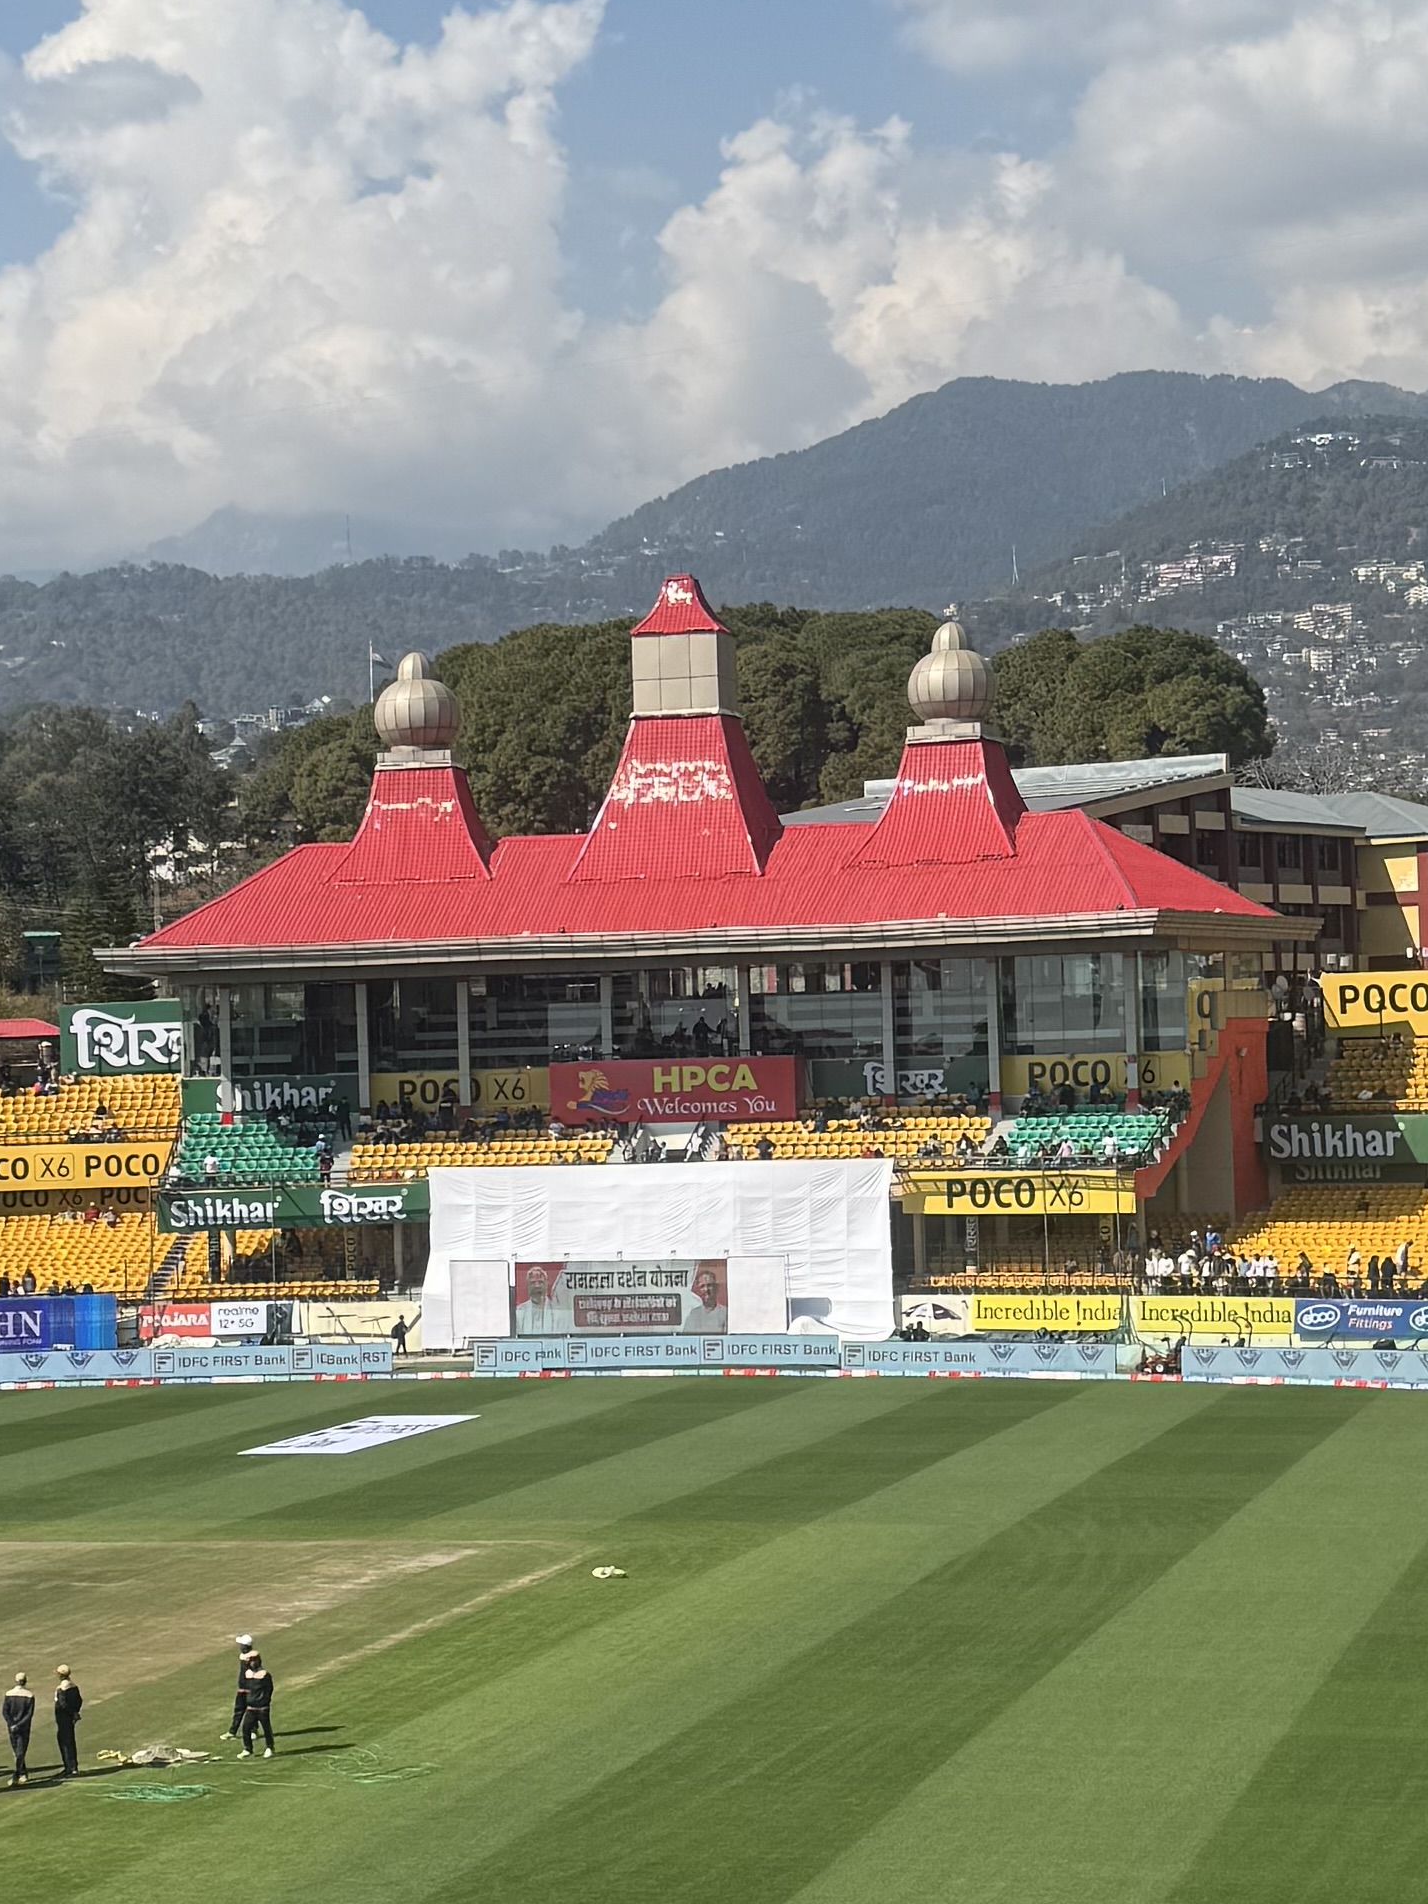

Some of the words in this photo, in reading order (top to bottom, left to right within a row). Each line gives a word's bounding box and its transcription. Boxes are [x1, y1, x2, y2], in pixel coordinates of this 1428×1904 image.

[652, 1064, 759, 1093] HPCA
[1028, 1059, 1111, 1088] POCO
[494, 1076, 526, 1100] X6
[637, 1097, 738, 1117] Welcomes
[744, 1095, 777, 1114] You
[1270, 1121, 1402, 1159] Shikhar
[39, 1155, 71, 1179] X6
[84, 1153, 161, 1178] POCO
[945, 1178, 1036, 1208] POCO
[1049, 1179, 1084, 1206] X6
[170, 1196, 279, 1228] Shikhar
[319, 1189, 408, 1224] शिखर
[217, 1305, 260, 1316] realme
[975, 1299, 1070, 1322] Incredible
[1140, 1300, 1238, 1323] Incredible
[1347, 1304, 1403, 1317] Furniture
[1348, 1318, 1393, 1331] Fittings
[178, 1355, 209, 1368] IDFC
[213, 1354, 251, 1367] FIRST
[254, 1353, 287, 1366] Bank
[327, 1353, 359, 1366] Bank
[501, 1350, 532, 1363] IDFC
[590, 1346, 623, 1359] IDFC
[625, 1345, 662, 1357] FIRST
[665, 1344, 699, 1357] Bank
[727, 1343, 758, 1356] IDFC
[762, 1343, 799, 1356] FIRST
[803, 1343, 837, 1356] Bank
[868, 1349, 899, 1362] IDFC
[902, 1350, 940, 1363] FIRST
[943, 1351, 977, 1364] Bank
